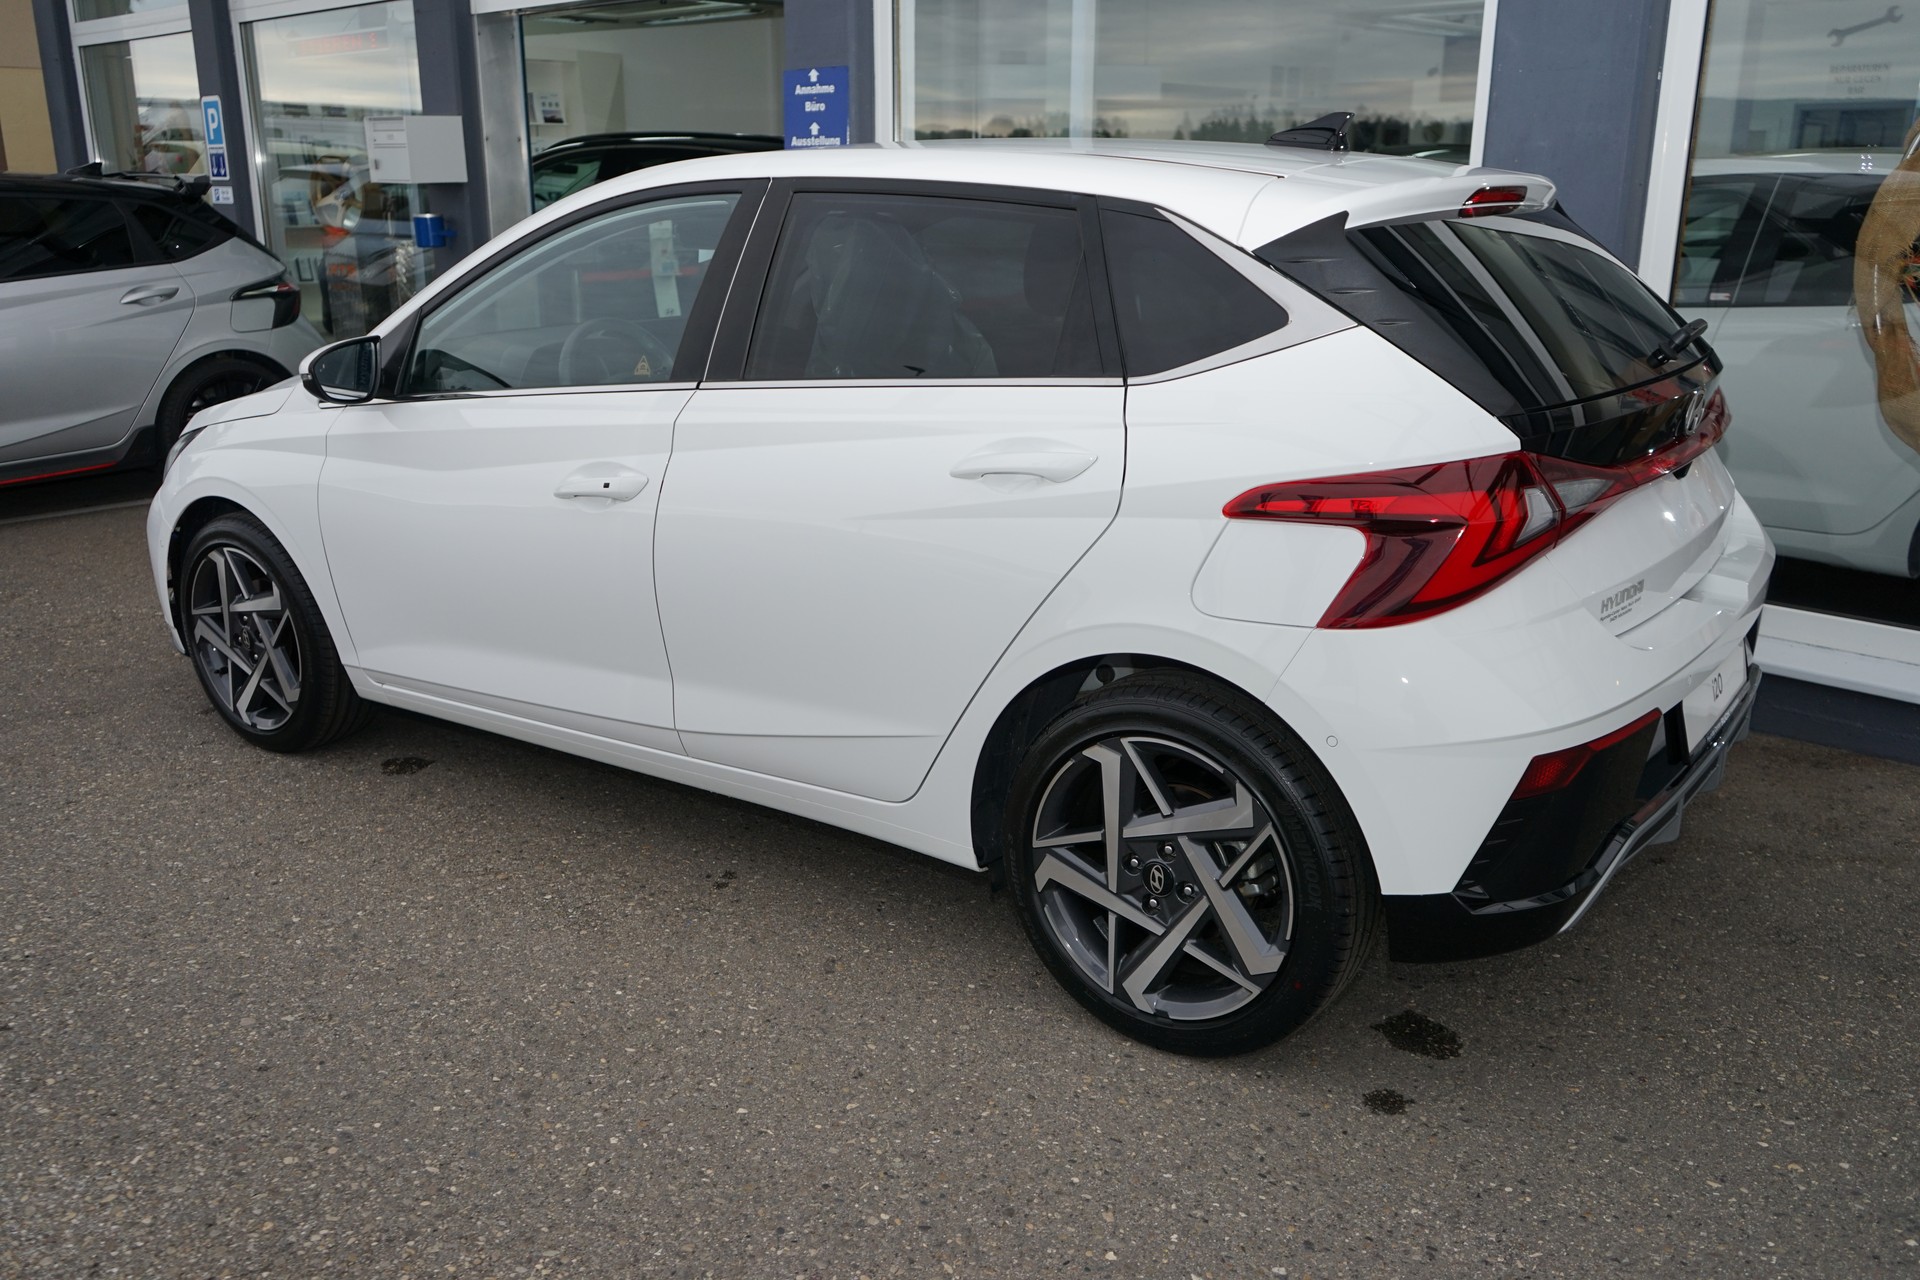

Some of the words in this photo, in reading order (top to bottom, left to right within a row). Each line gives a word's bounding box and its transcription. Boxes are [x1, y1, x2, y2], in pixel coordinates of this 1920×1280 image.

[795, 83, 835, 95] Annahme
[805, 101, 826, 112] Büro
[207, 107, 218, 140] P
[791, 135, 841, 146] Ausstellung
[1712, 672, 1723, 702] i20
